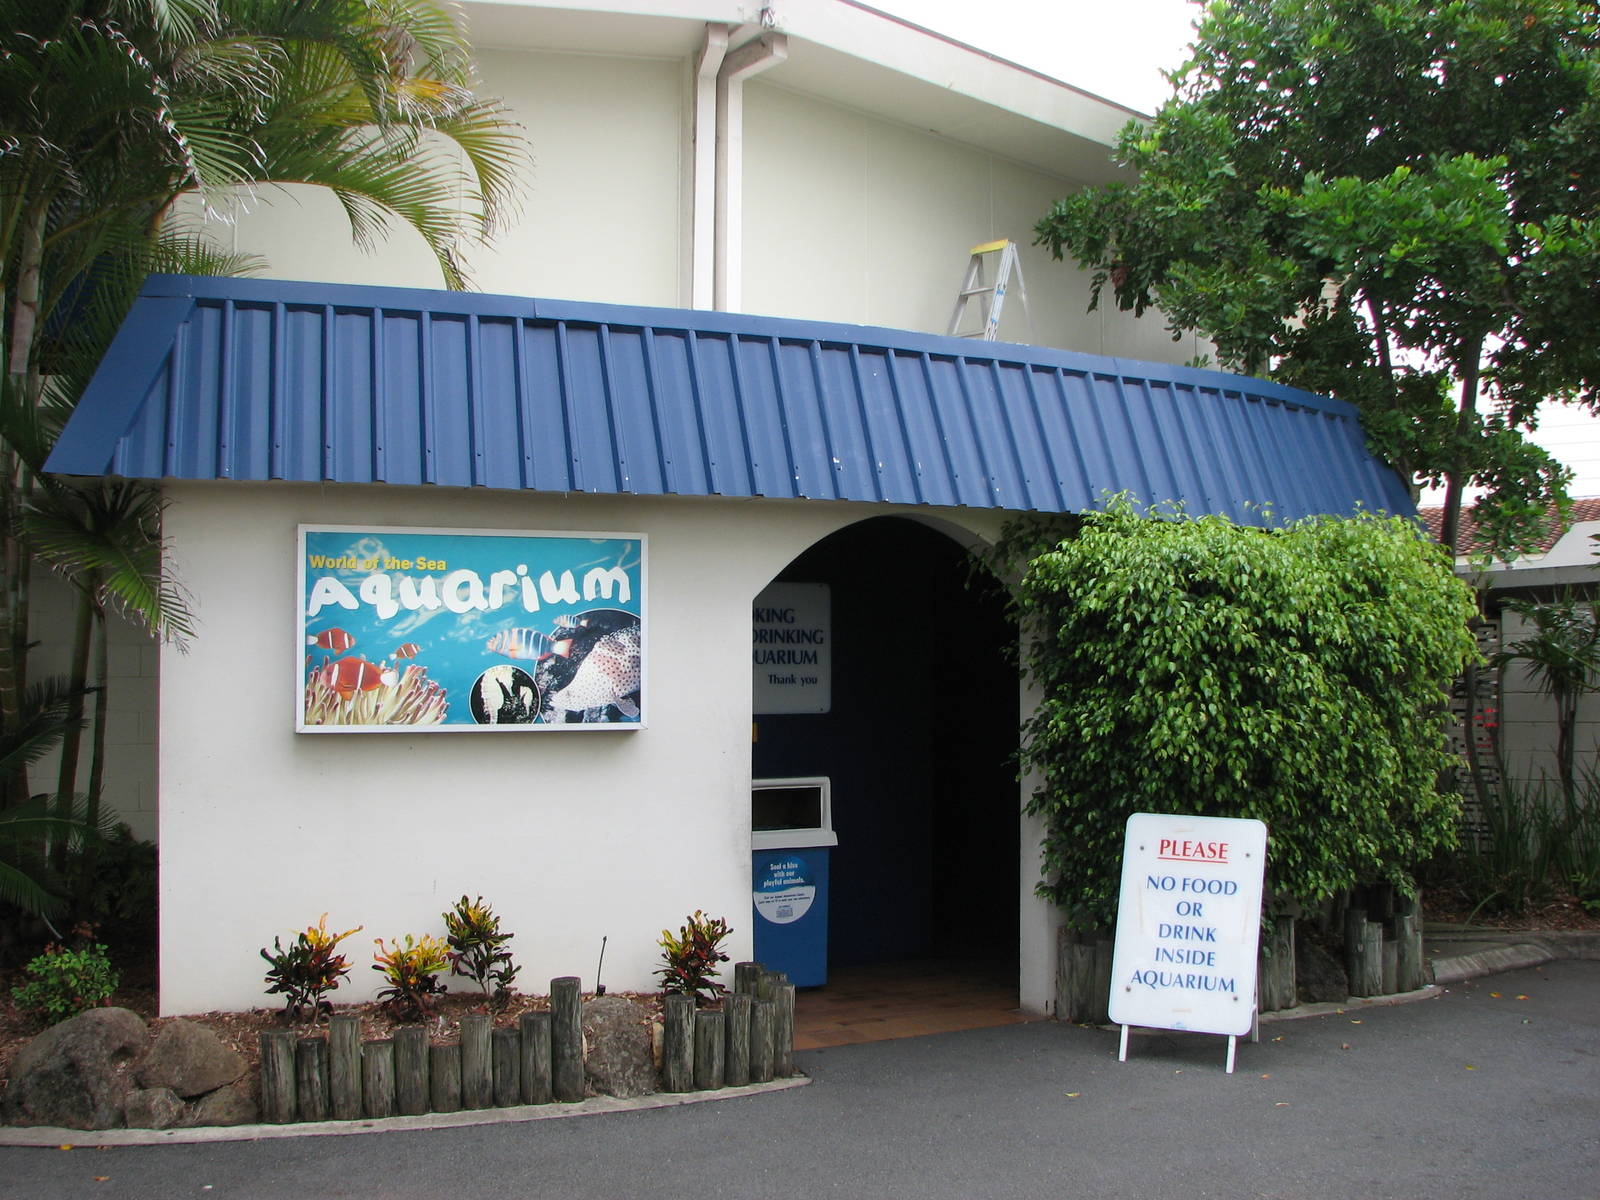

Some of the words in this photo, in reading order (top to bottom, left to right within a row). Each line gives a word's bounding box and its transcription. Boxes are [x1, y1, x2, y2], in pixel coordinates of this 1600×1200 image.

[309, 555, 357, 569] World
[363, 558, 380, 569] of
[384, 557, 413, 570] the
[416, 557, 447, 570] Sea
[308, 564, 632, 620] Aquarium
[753, 608, 795, 624] KING
[753, 650, 818, 664] UARIUM
[768, 674, 797, 685] Thank
[801, 676, 818, 687] you
[1159, 839, 1229, 860] PLEASE
[1146, 875, 1176, 891] NO
[1181, 877, 1238, 895] FOOD
[1176, 901, 1203, 917] OR
[1158, 923, 1217, 942] DRINK
[1154, 947, 1216, 967] INSIDE
[1130, 970, 1235, 993] AQUARIUM
